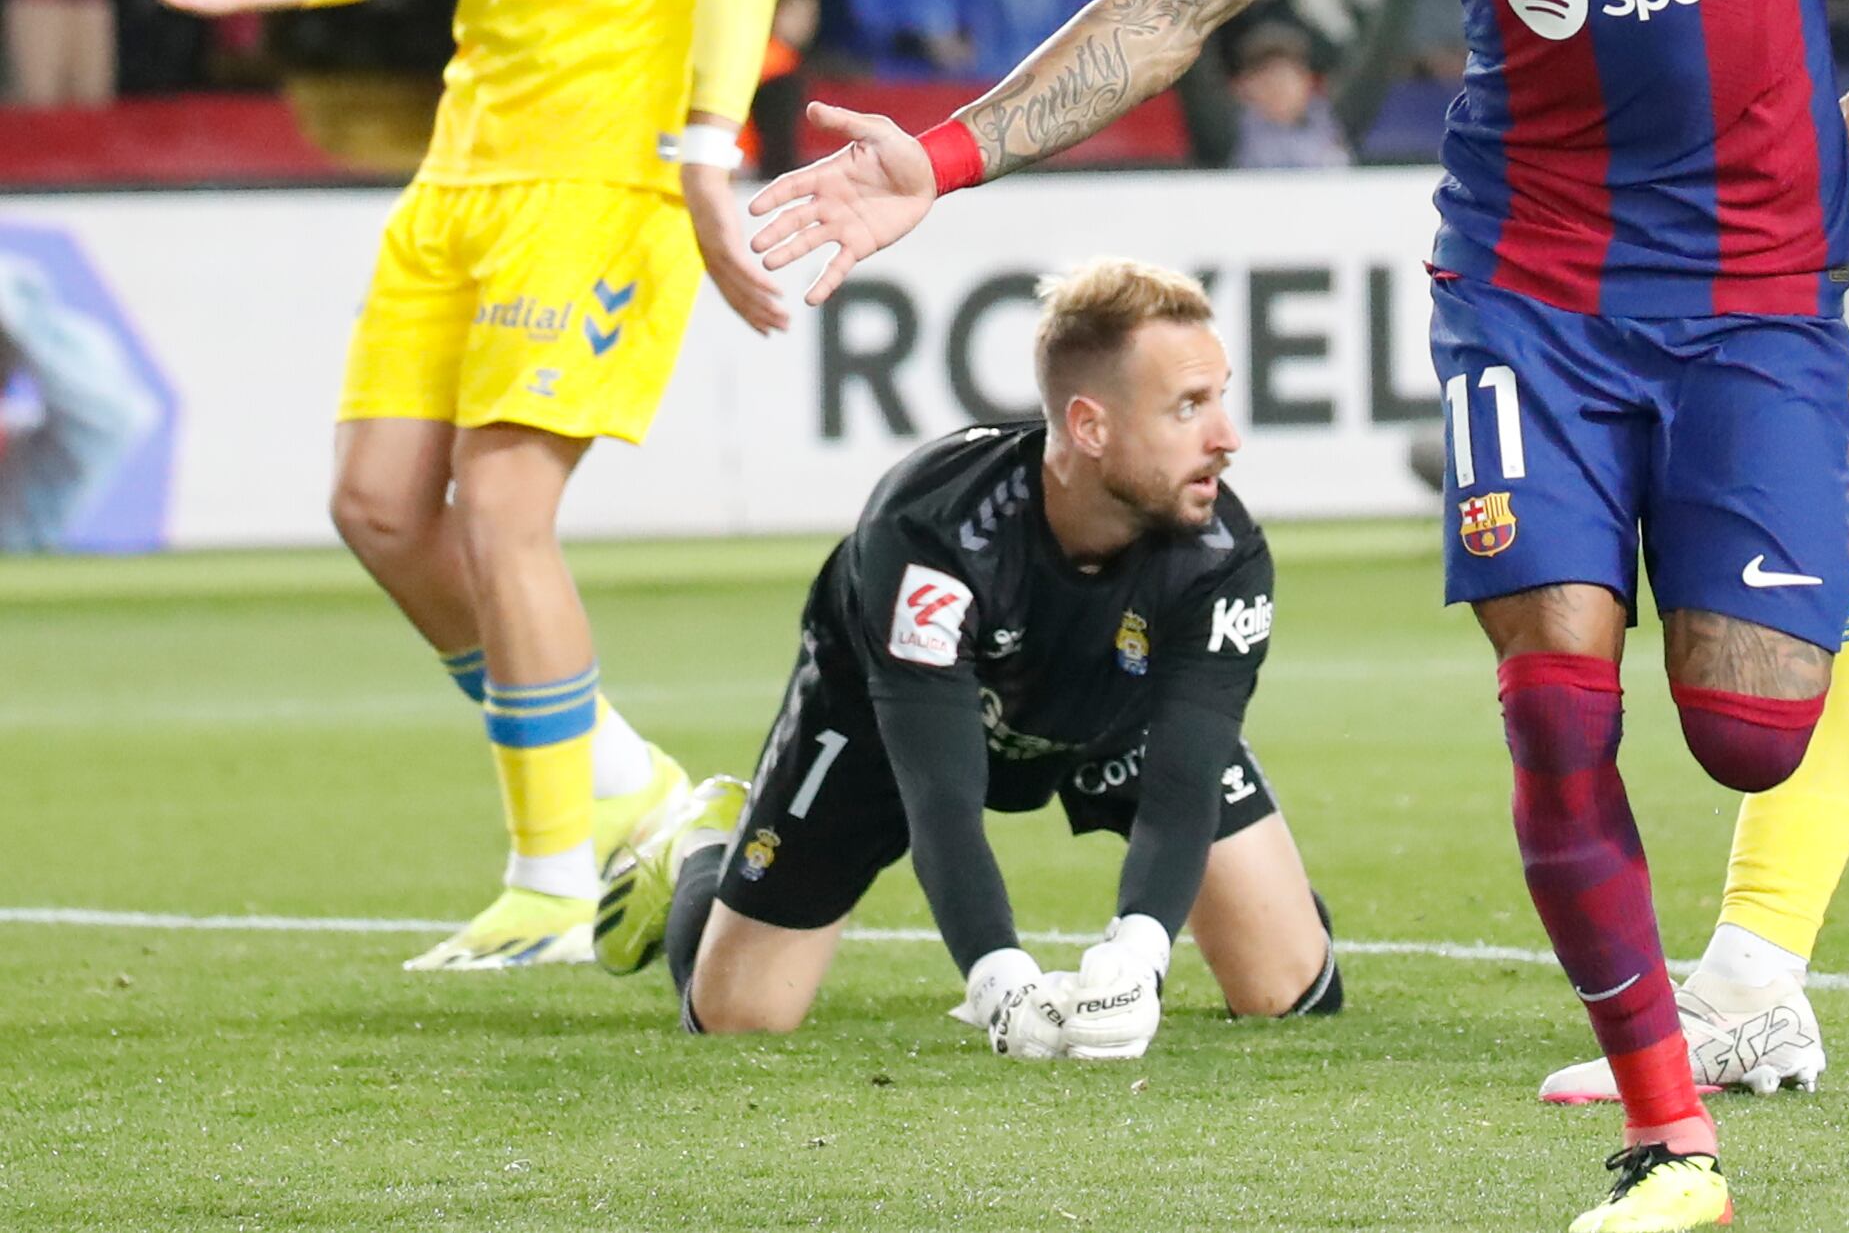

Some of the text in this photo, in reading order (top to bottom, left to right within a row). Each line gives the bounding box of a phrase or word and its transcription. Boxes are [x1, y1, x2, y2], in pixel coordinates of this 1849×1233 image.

[474, 296, 573, 330] ordial
[1446, 366, 1525, 488] 11
[787, 728, 849, 819] 1
